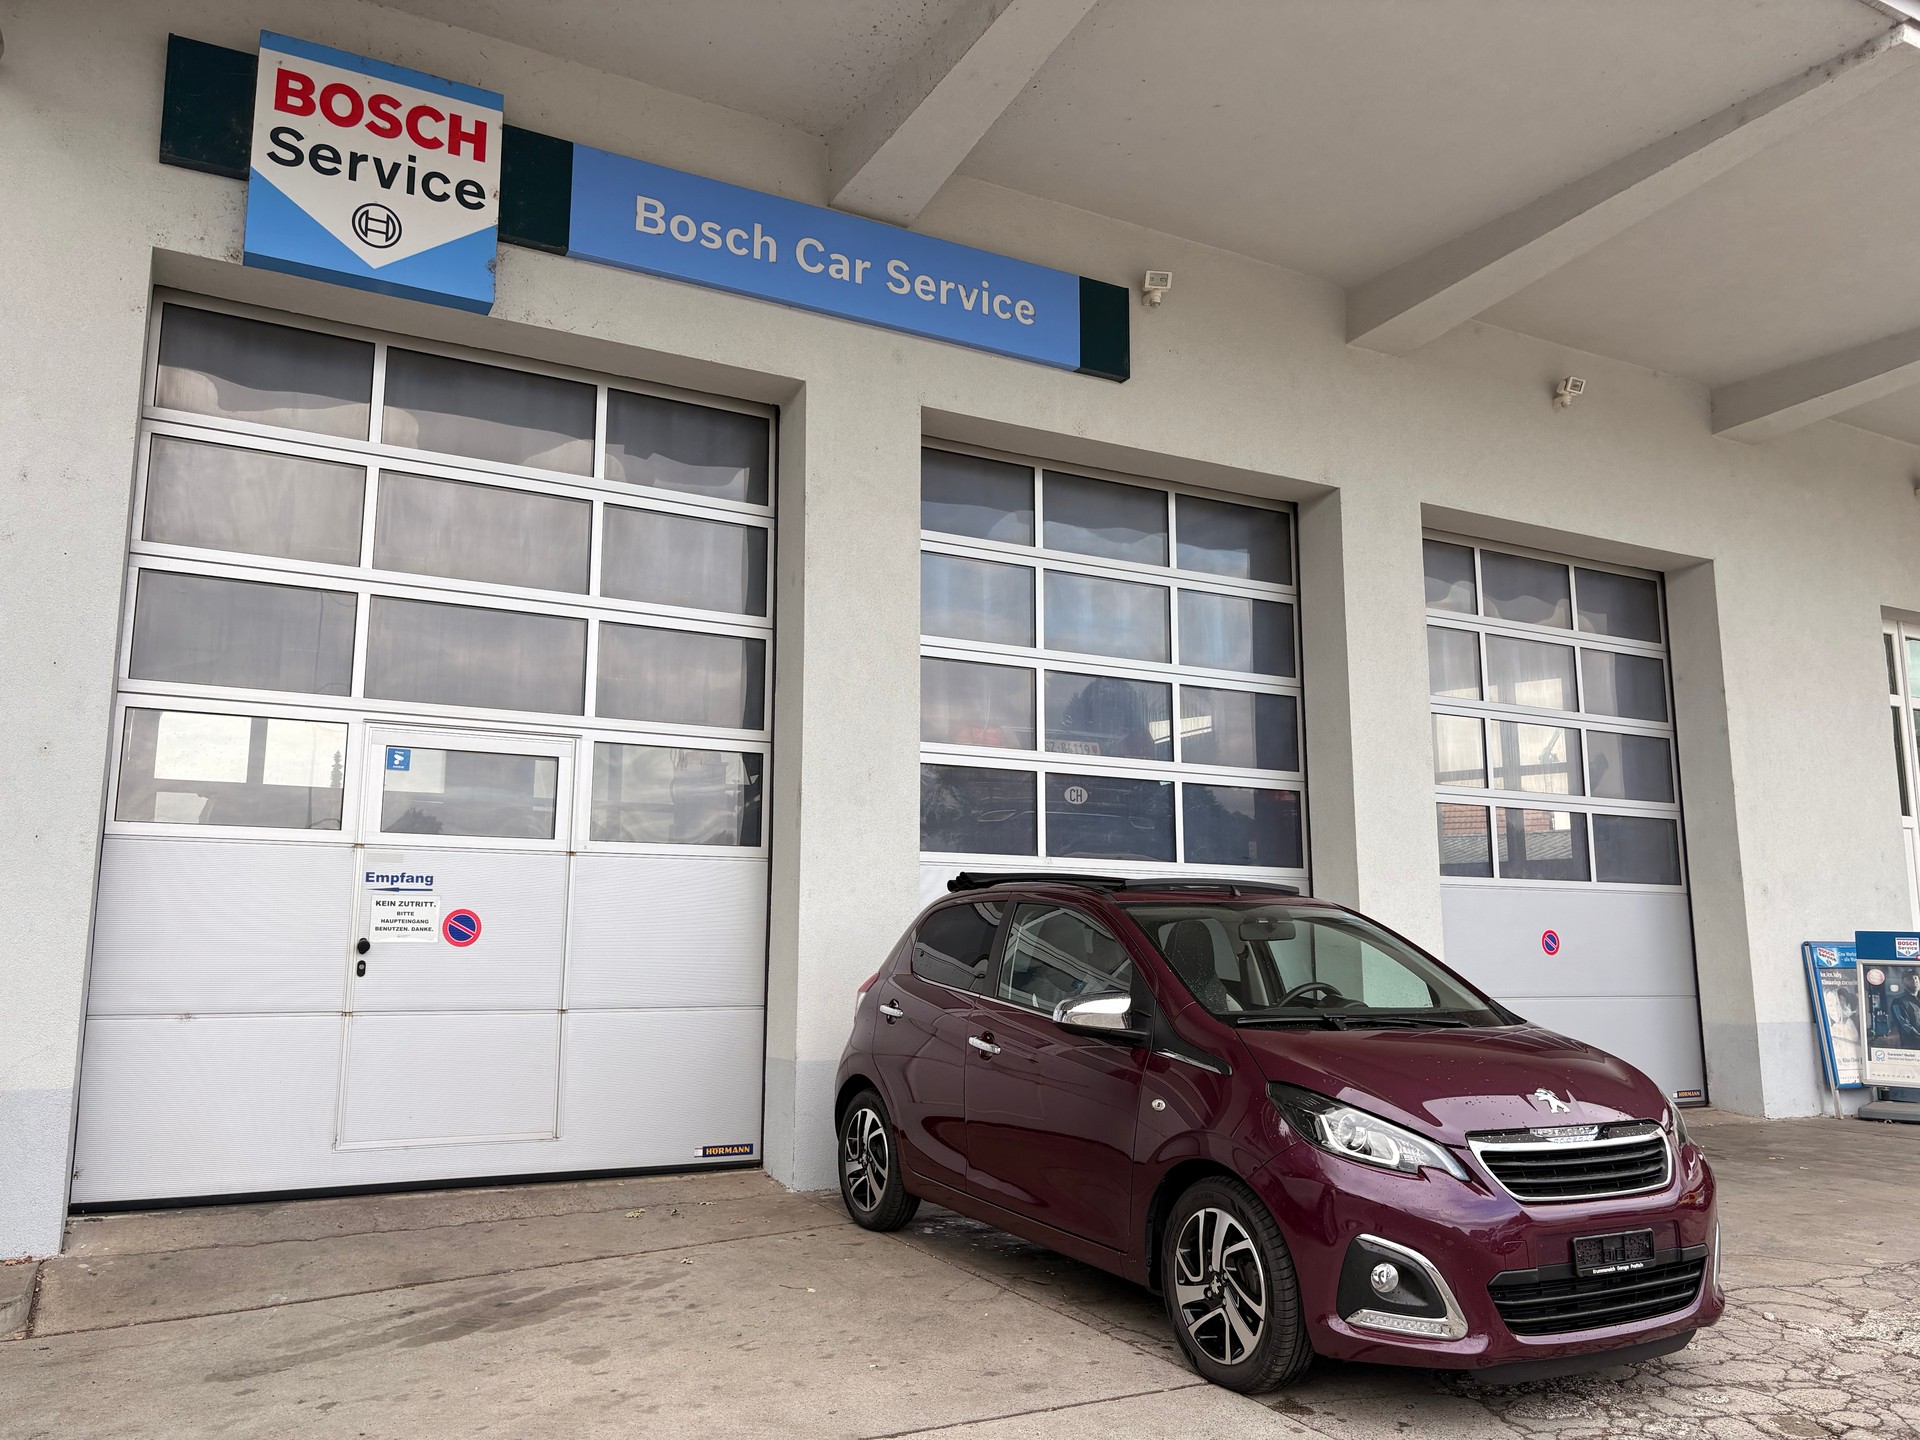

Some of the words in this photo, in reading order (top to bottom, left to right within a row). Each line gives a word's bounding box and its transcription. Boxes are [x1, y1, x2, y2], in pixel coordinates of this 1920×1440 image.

[273, 67, 488, 164] BOSCH
[266, 126, 487, 211] Service
[634, 194, 778, 264] Bosch
[795, 236, 872, 285] Car
[886, 259, 1037, 326] Service
[1069, 788, 1083, 802] CH
[365, 871, 434, 886] Empfang
[397, 900, 437, 908] ZUTRITT.
